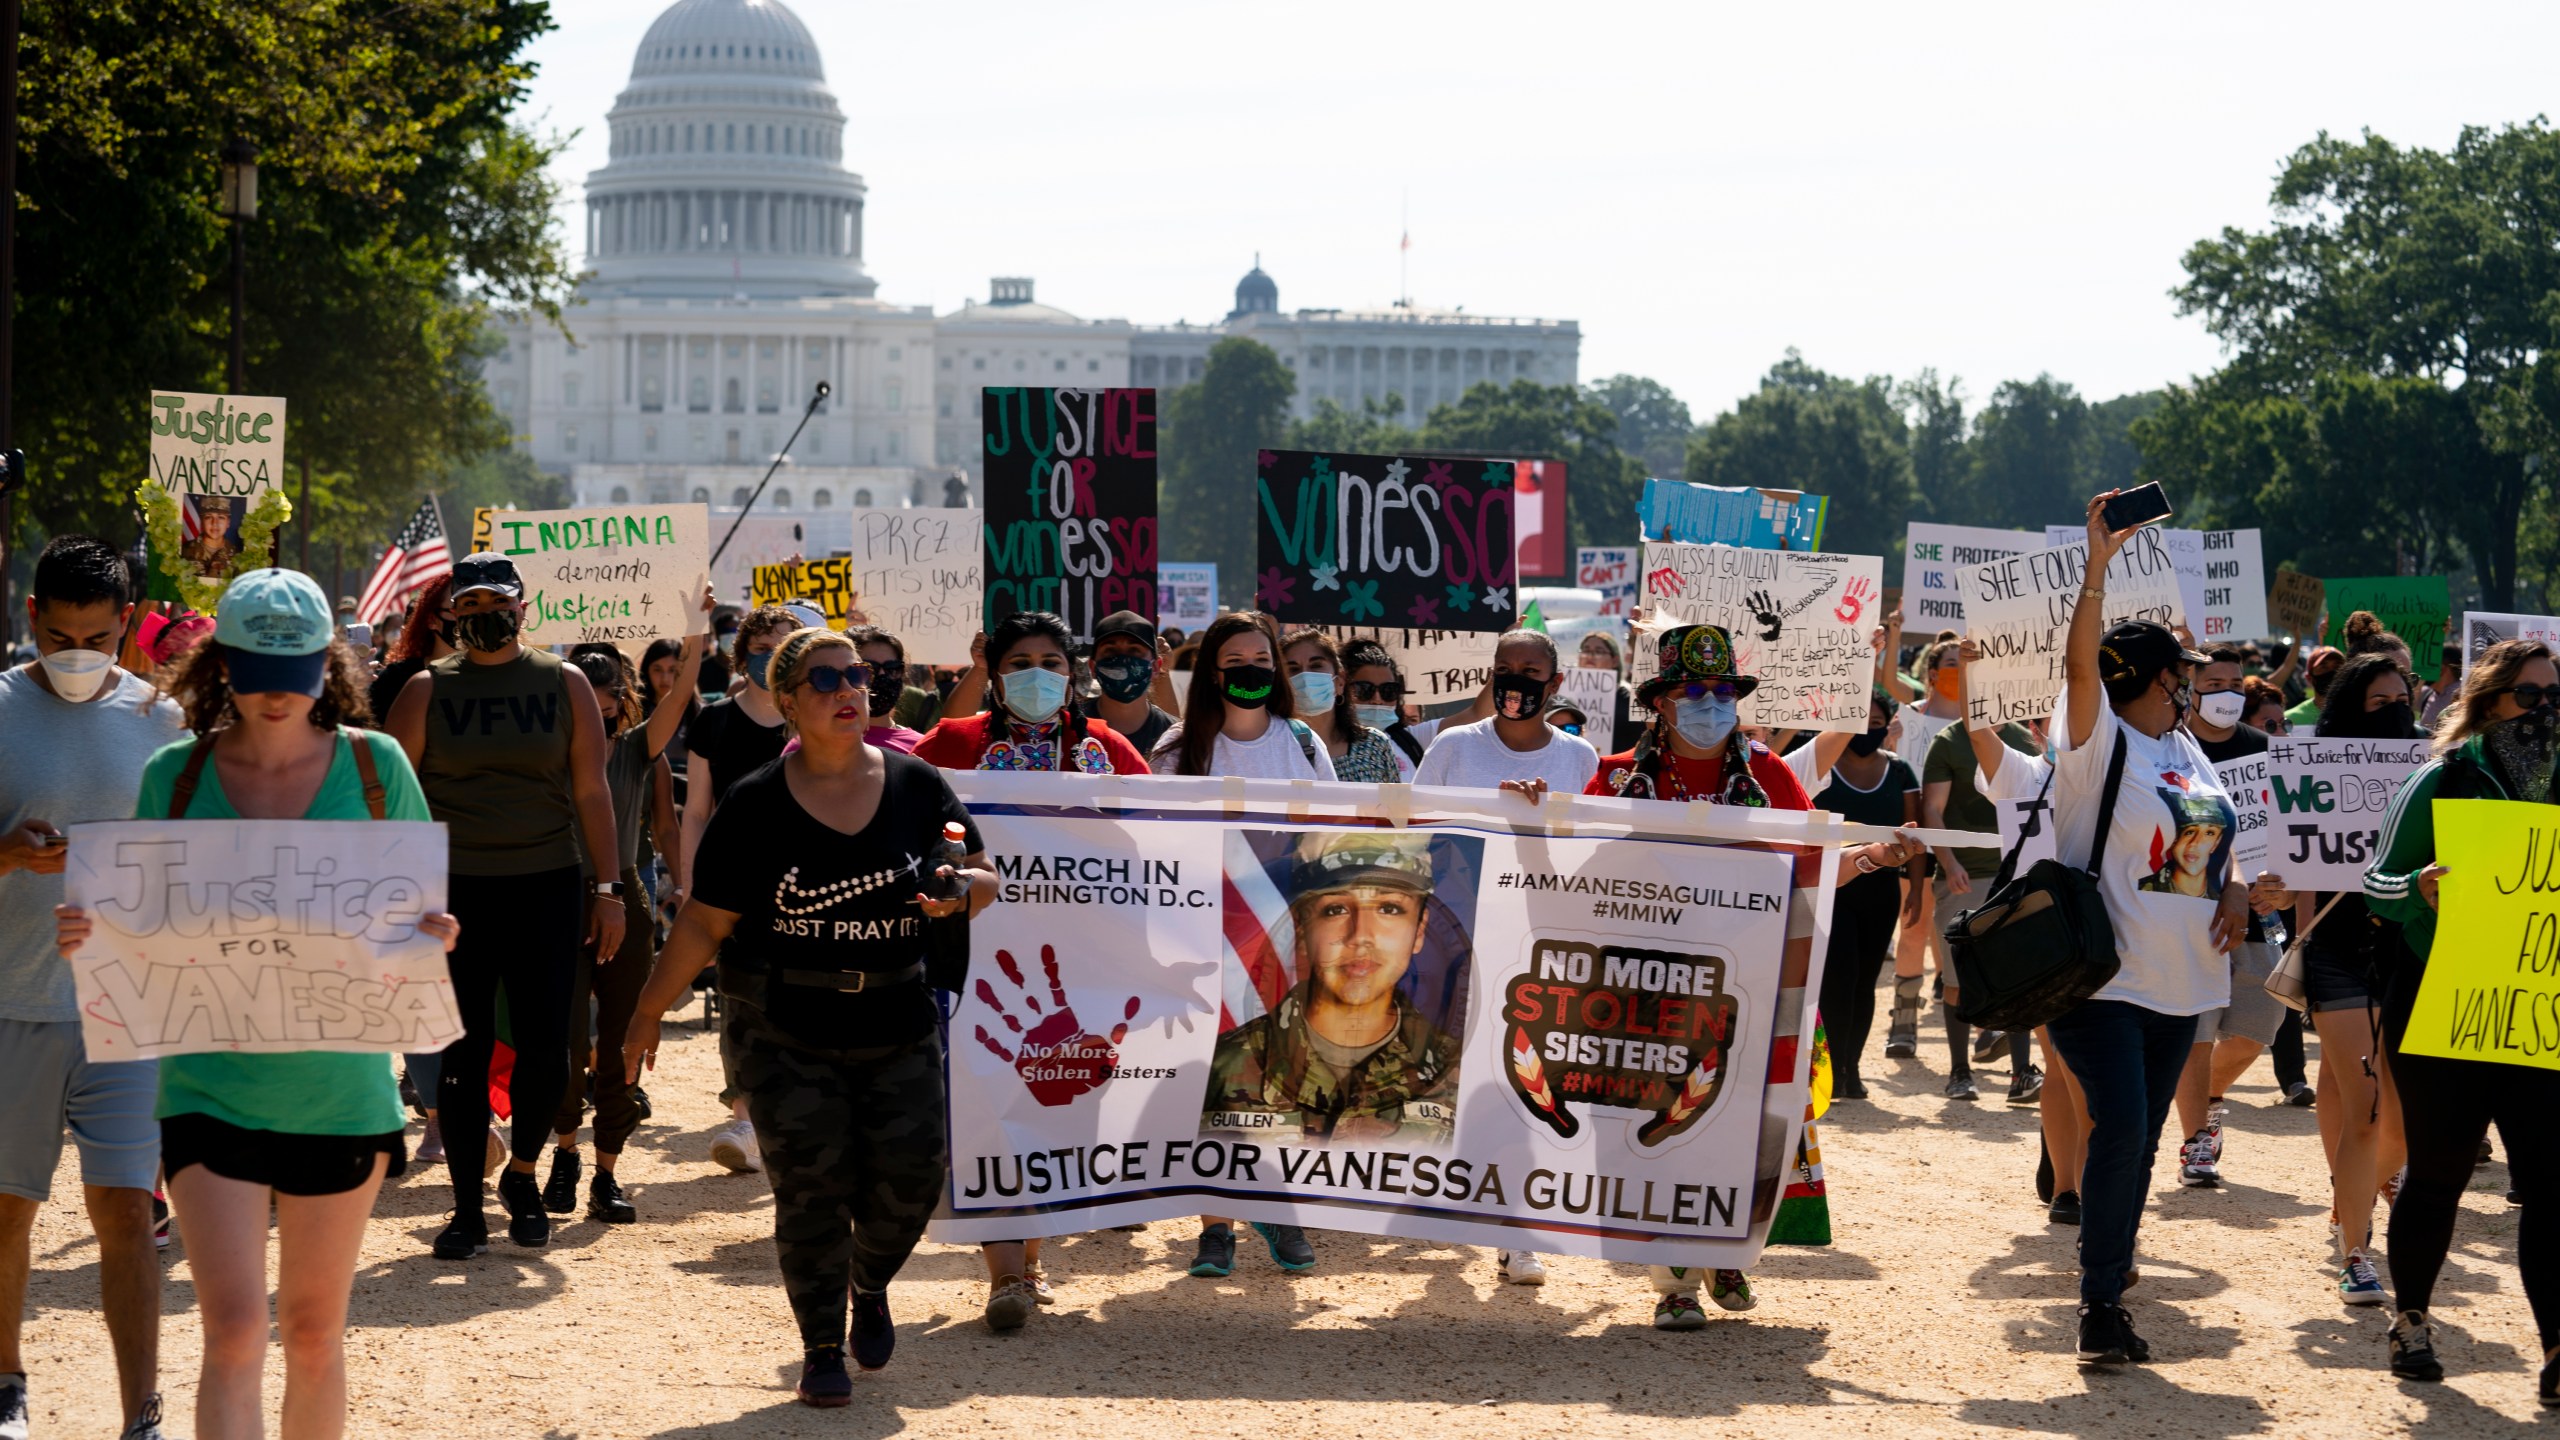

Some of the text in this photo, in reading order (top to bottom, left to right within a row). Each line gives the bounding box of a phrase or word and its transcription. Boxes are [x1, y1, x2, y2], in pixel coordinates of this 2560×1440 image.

[151, 395, 273, 446] Justice
[986, 387, 1157, 459] JUSTICE
[152, 453, 270, 496] VANESSA
[501, 515, 676, 556] INDIANA
[859, 511, 949, 566] PREZ
[1259, 469, 1517, 589] vanessa
[985, 517, 1158, 578] vanessa
[1646, 547, 1779, 581] VANESSA GUILLEN
[1914, 543, 1944, 562] SHE
[1979, 559, 2027, 602] SHE
[2121, 527, 2172, 578] FOR
[556, 558, 651, 582] demanda
[1923, 571, 1946, 589] US.
[2207, 561, 2239, 579] WHO
[526, 591, 653, 631] Justicia 4
[579, 624, 660, 643] VANESSA
[1817, 628, 1861, 647] HOOD
[1980, 630, 2027, 660] NOW
[2034, 626, 2060, 654] WE
[1768, 647, 1871, 663] THE GREAT PLACE
[1778, 662, 1855, 678] TO GET LOST
[1773, 682, 1861, 700] TO GET RAPED
[440, 692, 557, 736] VFW
[1772, 705, 1868, 722] TO GET KILLED
[2270, 774, 2335, 815] We
[996, 855, 1180, 886] MARCH IN
[95, 841, 424, 943] Justice
[1158, 889, 1214, 908] D.C.
[1498, 873, 1782, 913] #IAMVANESSAGUILLEN
[773, 918, 826, 938] JUST
[834, 918, 896, 940] PRAY
[1593, 900, 1683, 925] #MMIW
[219, 939, 297, 958] FOR
[1540, 949, 1716, 998] NO MORE
[91, 960, 459, 1048] VANESSA
[1512, 983, 1729, 1042] STOLEN
[2451, 985, 2560, 1059] VANESS
[1021, 1043, 1119, 1060] No More
[1544, 1031, 1689, 1075] SISTERS
[1022, 1064, 1177, 1083] Stolen Sisters
[1562, 1071, 1666, 1101] #MMIW
[1211, 1112, 1273, 1129] GUILLEN
[964, 1140, 1739, 1229] JUSTICE FOR VANESSA GUILLEN
